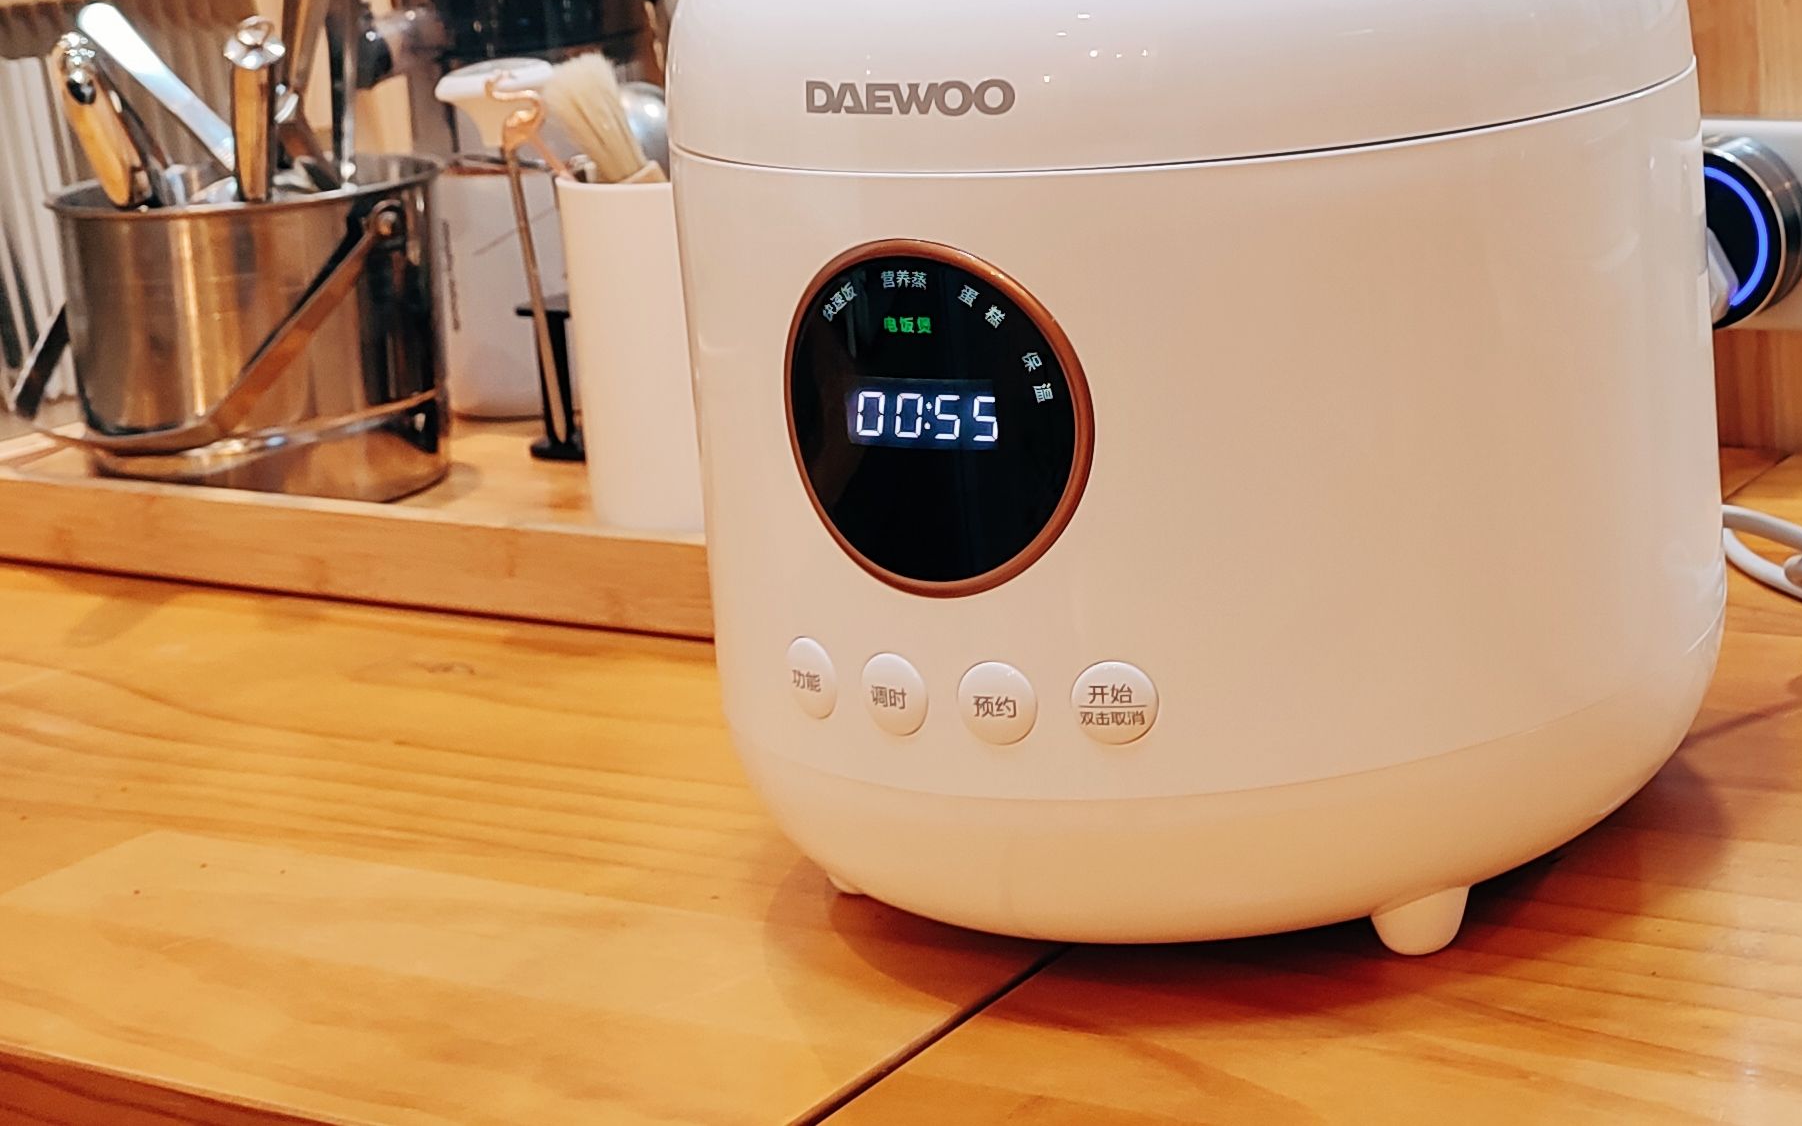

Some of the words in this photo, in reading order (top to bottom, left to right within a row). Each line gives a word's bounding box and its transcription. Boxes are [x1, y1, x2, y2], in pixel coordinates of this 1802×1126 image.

[806, 79, 1015, 116] DAEWOO
[881, 270, 927, 290] 营养蒸
[822, 281, 857, 322] 快速饭
[957, 284, 1006, 329] 蛋糕
[883, 316, 932, 334] 电饭煲
[1021, 351, 1054, 404] 保温
[856, 391, 999, 442] 00:55
[792, 670, 821, 693] 功能
[870, 685, 907, 710] 调时
[1088, 684, 1134, 705] 开始
[973, 696, 1017, 719] 预约
[1080, 711, 1145, 726] 双击取消
